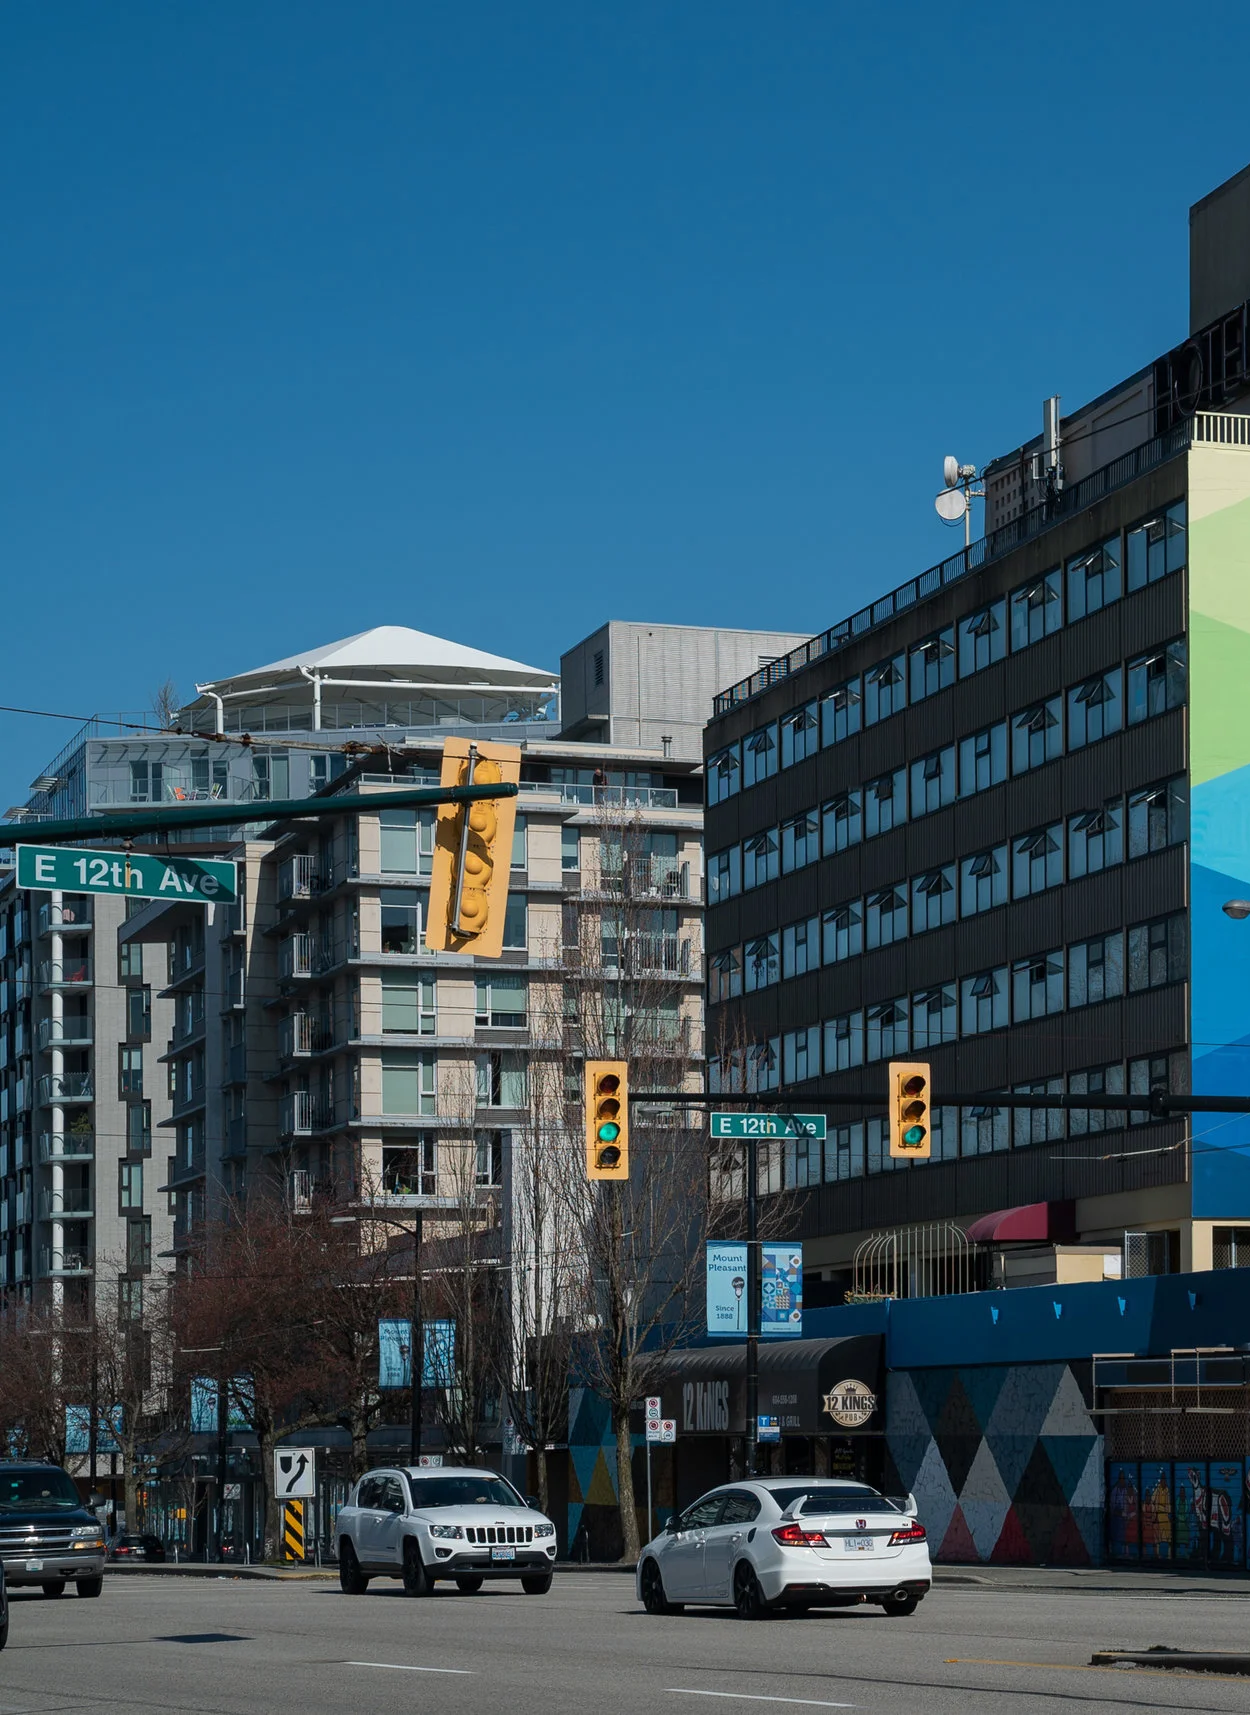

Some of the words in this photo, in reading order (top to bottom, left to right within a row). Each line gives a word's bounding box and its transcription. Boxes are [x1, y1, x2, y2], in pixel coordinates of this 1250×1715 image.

[35, 854, 57, 883] E
[73, 858, 144, 889] 12th
[159, 864, 219, 895] Ave
[720, 1117, 732, 1134] E
[739, 1117, 777, 1134] 12th
[784, 1119, 817, 1135] Ave
[712, 1254, 743, 1262] Mount
[708, 1263, 747, 1272] Pleasant
[683, 1382, 694, 1431] 12
[826, 1396, 838, 1411] 12
[841, 1395, 874, 1411] KINGS
[844, 1412, 858, 1421] PUB
